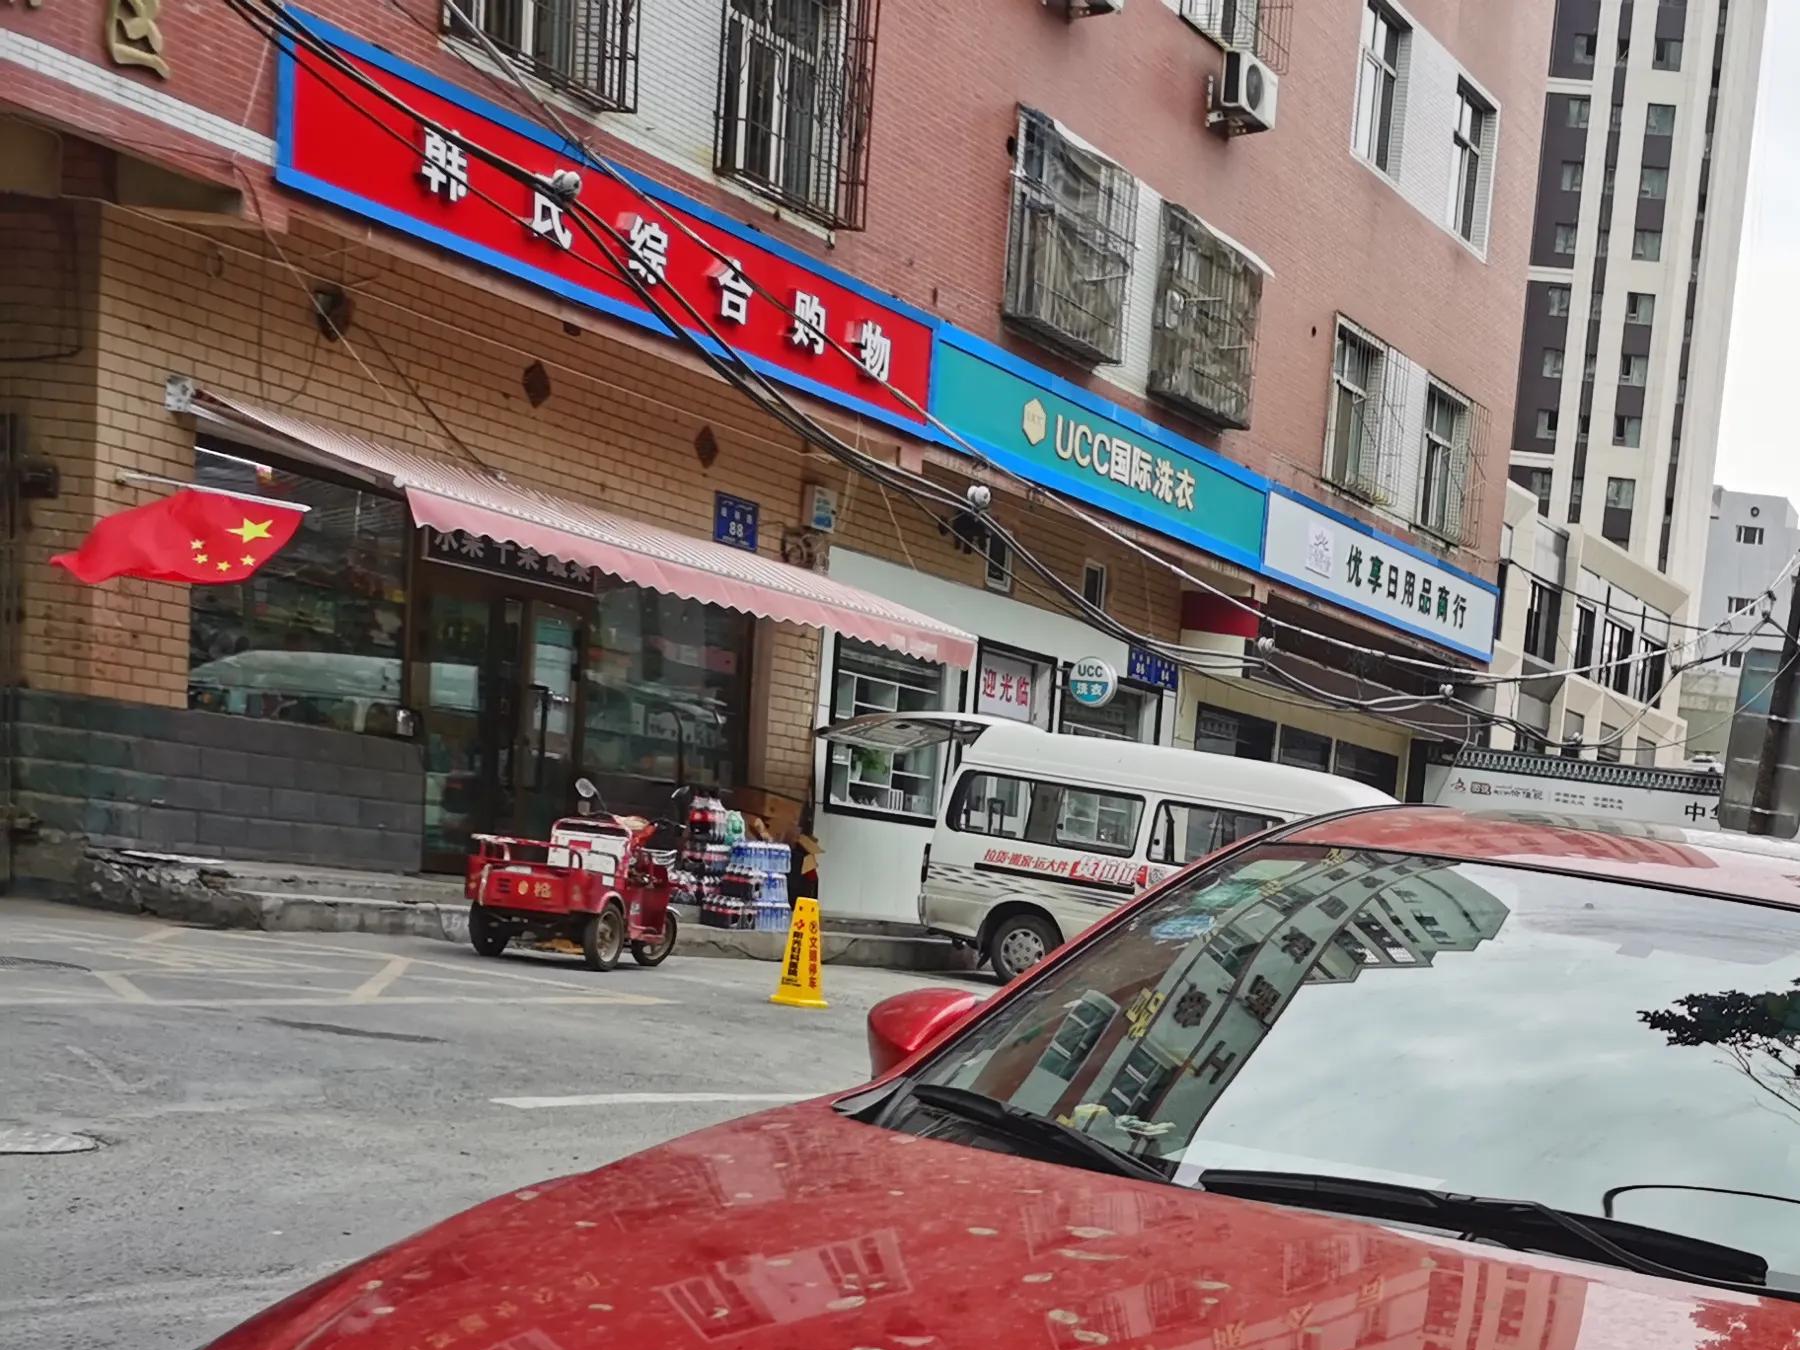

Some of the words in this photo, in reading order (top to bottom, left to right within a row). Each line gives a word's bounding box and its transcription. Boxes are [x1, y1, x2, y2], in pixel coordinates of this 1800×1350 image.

[420, 124, 891, 382] 韩氏综合购物
[1055, 413, 1196, 512] UCC国际洗衣
[728, 520, 745, 539] 88
[1346, 543, 1468, 630] 优享日用品商行
[1077, 665, 1104, 679] UCC
